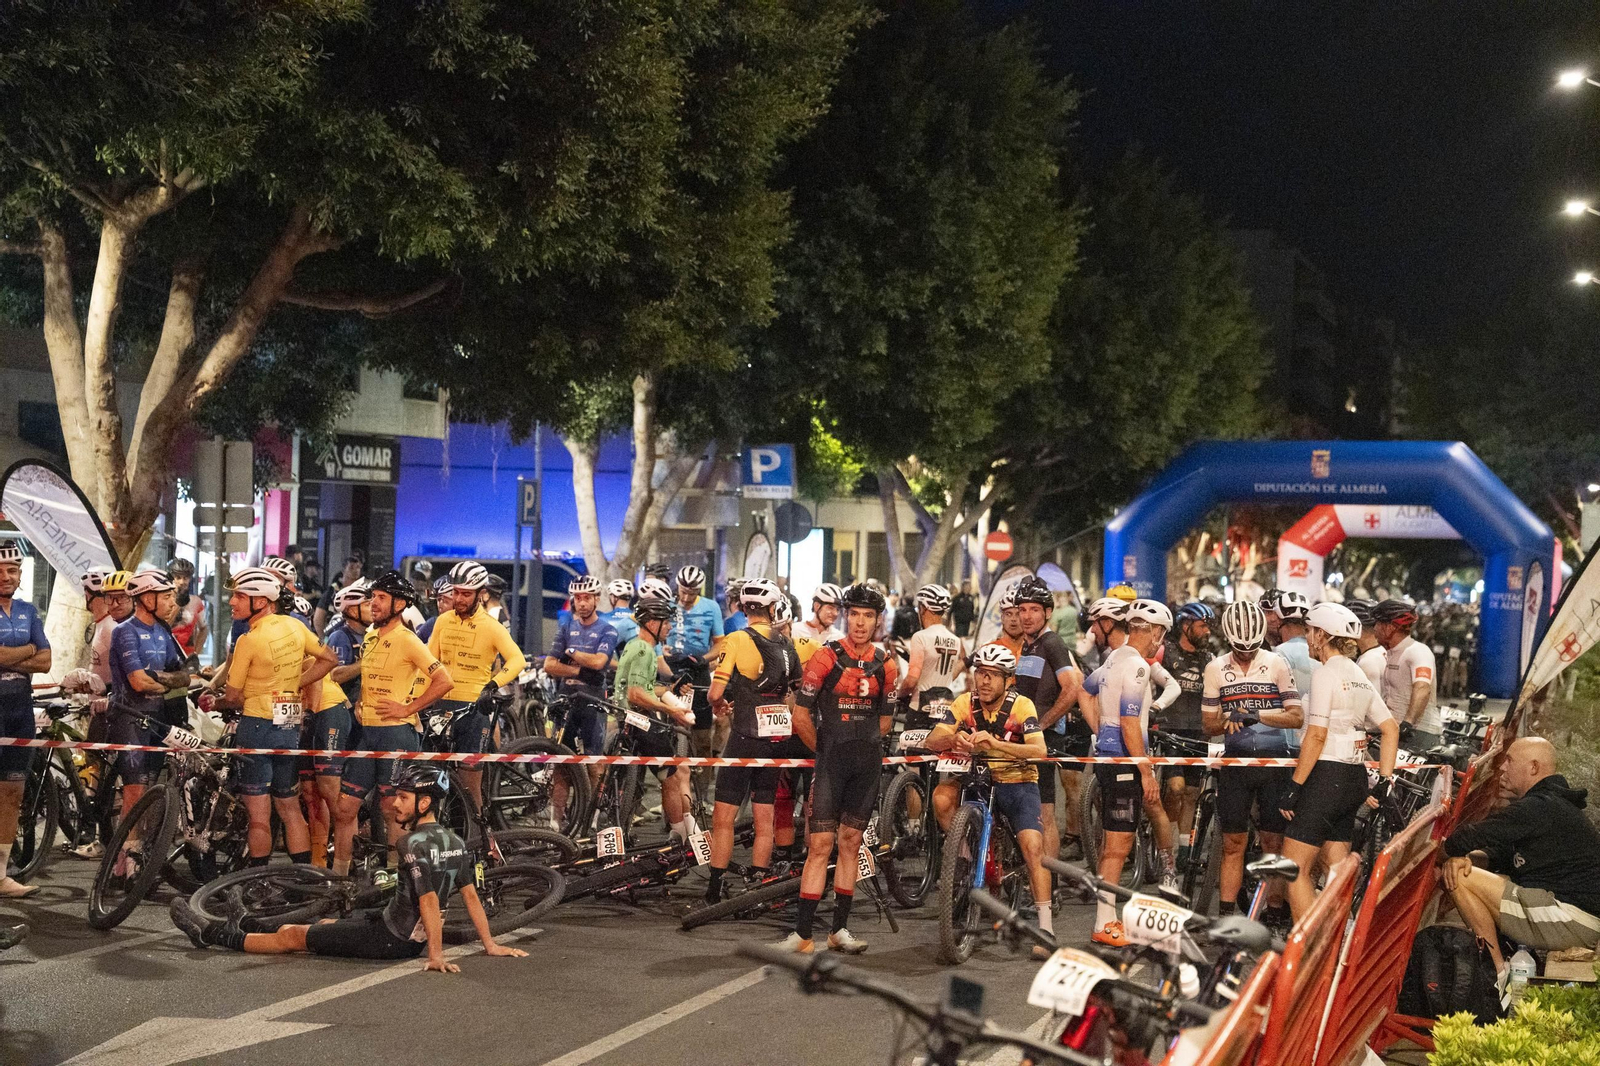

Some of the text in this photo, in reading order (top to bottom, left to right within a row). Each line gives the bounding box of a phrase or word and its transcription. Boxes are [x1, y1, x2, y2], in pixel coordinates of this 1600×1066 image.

[342, 445, 392, 468] GOMAR
[751, 449, 781, 483] P
[1253, 481, 1388, 494] DIPUTACIÓN DE ALMERÍA
[524, 484, 535, 521] P
[1224, 684, 1271, 696] BIKESTORE
[281, 704, 300, 716] 5130
[838, 697, 872, 705] ESPEJO
[1228, 698, 1272, 711] ALMERÍA
[766, 714, 788, 726] 7005
[174, 730, 199, 749] 5130
[904, 732, 925, 741] 6296
[603, 832, 616, 854] 6709
[697, 838, 711, 861] 7005
[440, 848, 463, 858] HARMAN
[858, 853, 871, 877] 6653
[1135, 907, 1179, 934] 7886
[1049, 963, 1095, 991] 7211
